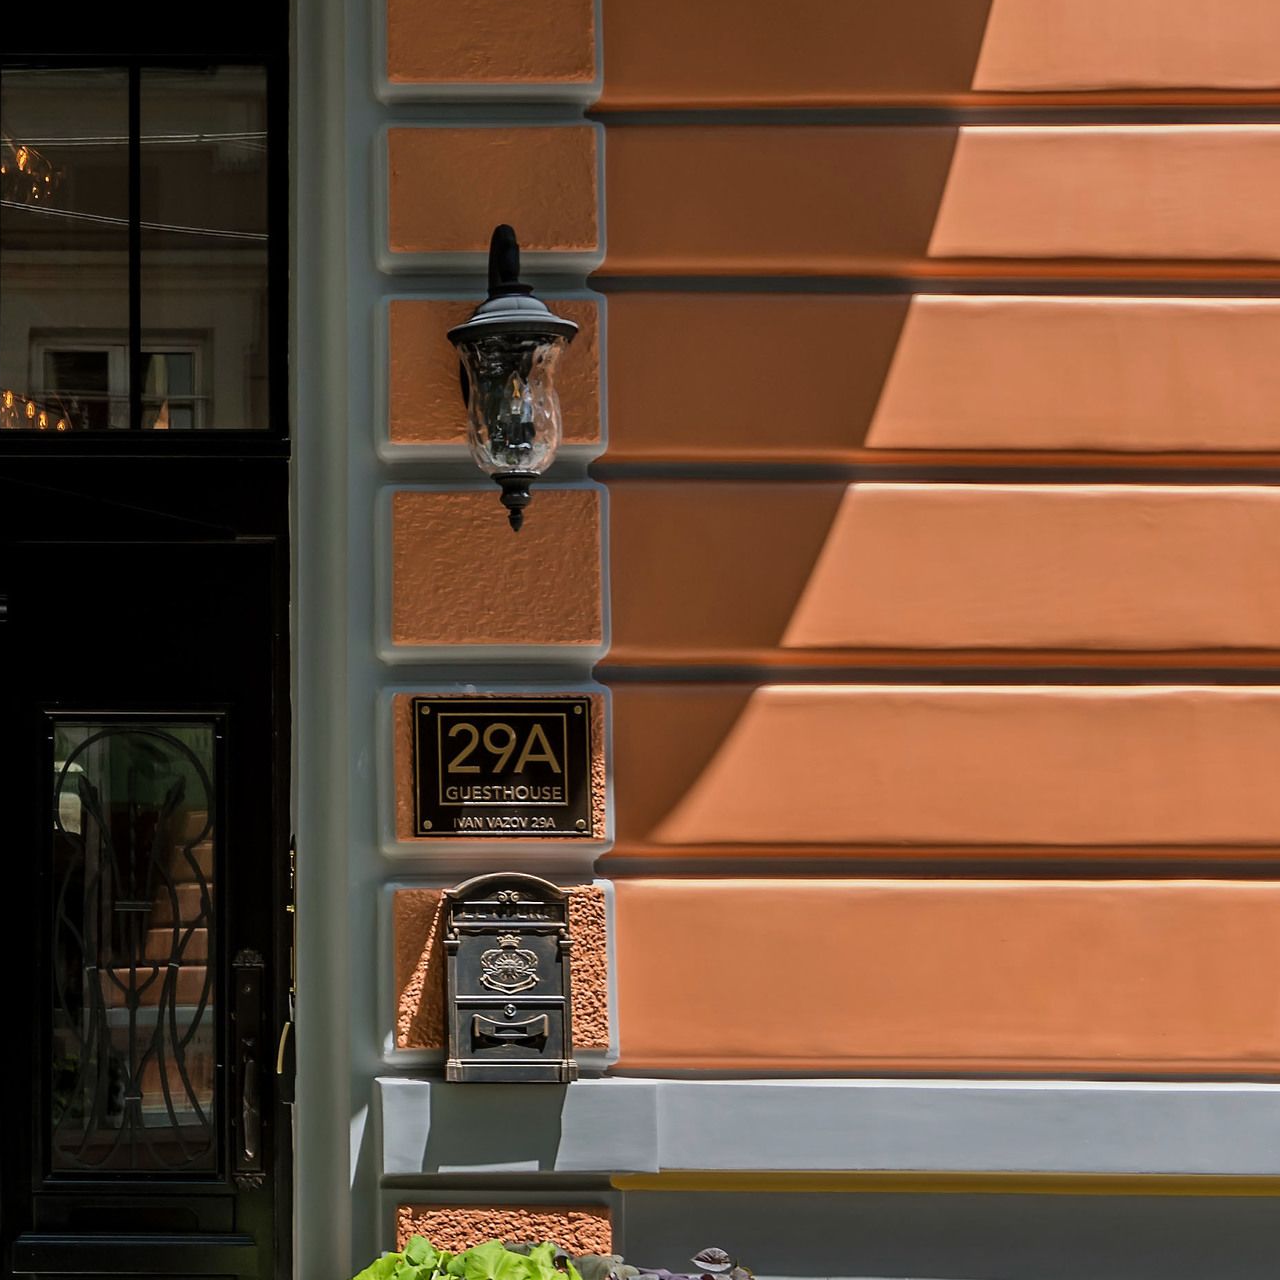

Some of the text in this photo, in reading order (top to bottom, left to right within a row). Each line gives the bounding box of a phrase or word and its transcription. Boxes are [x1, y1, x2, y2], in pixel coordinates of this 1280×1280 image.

[447, 723, 562, 773] 29A
[446, 785, 562, 800] GUESTHOUSE
[453, 816, 556, 829] IVAN VAZOV 29A
